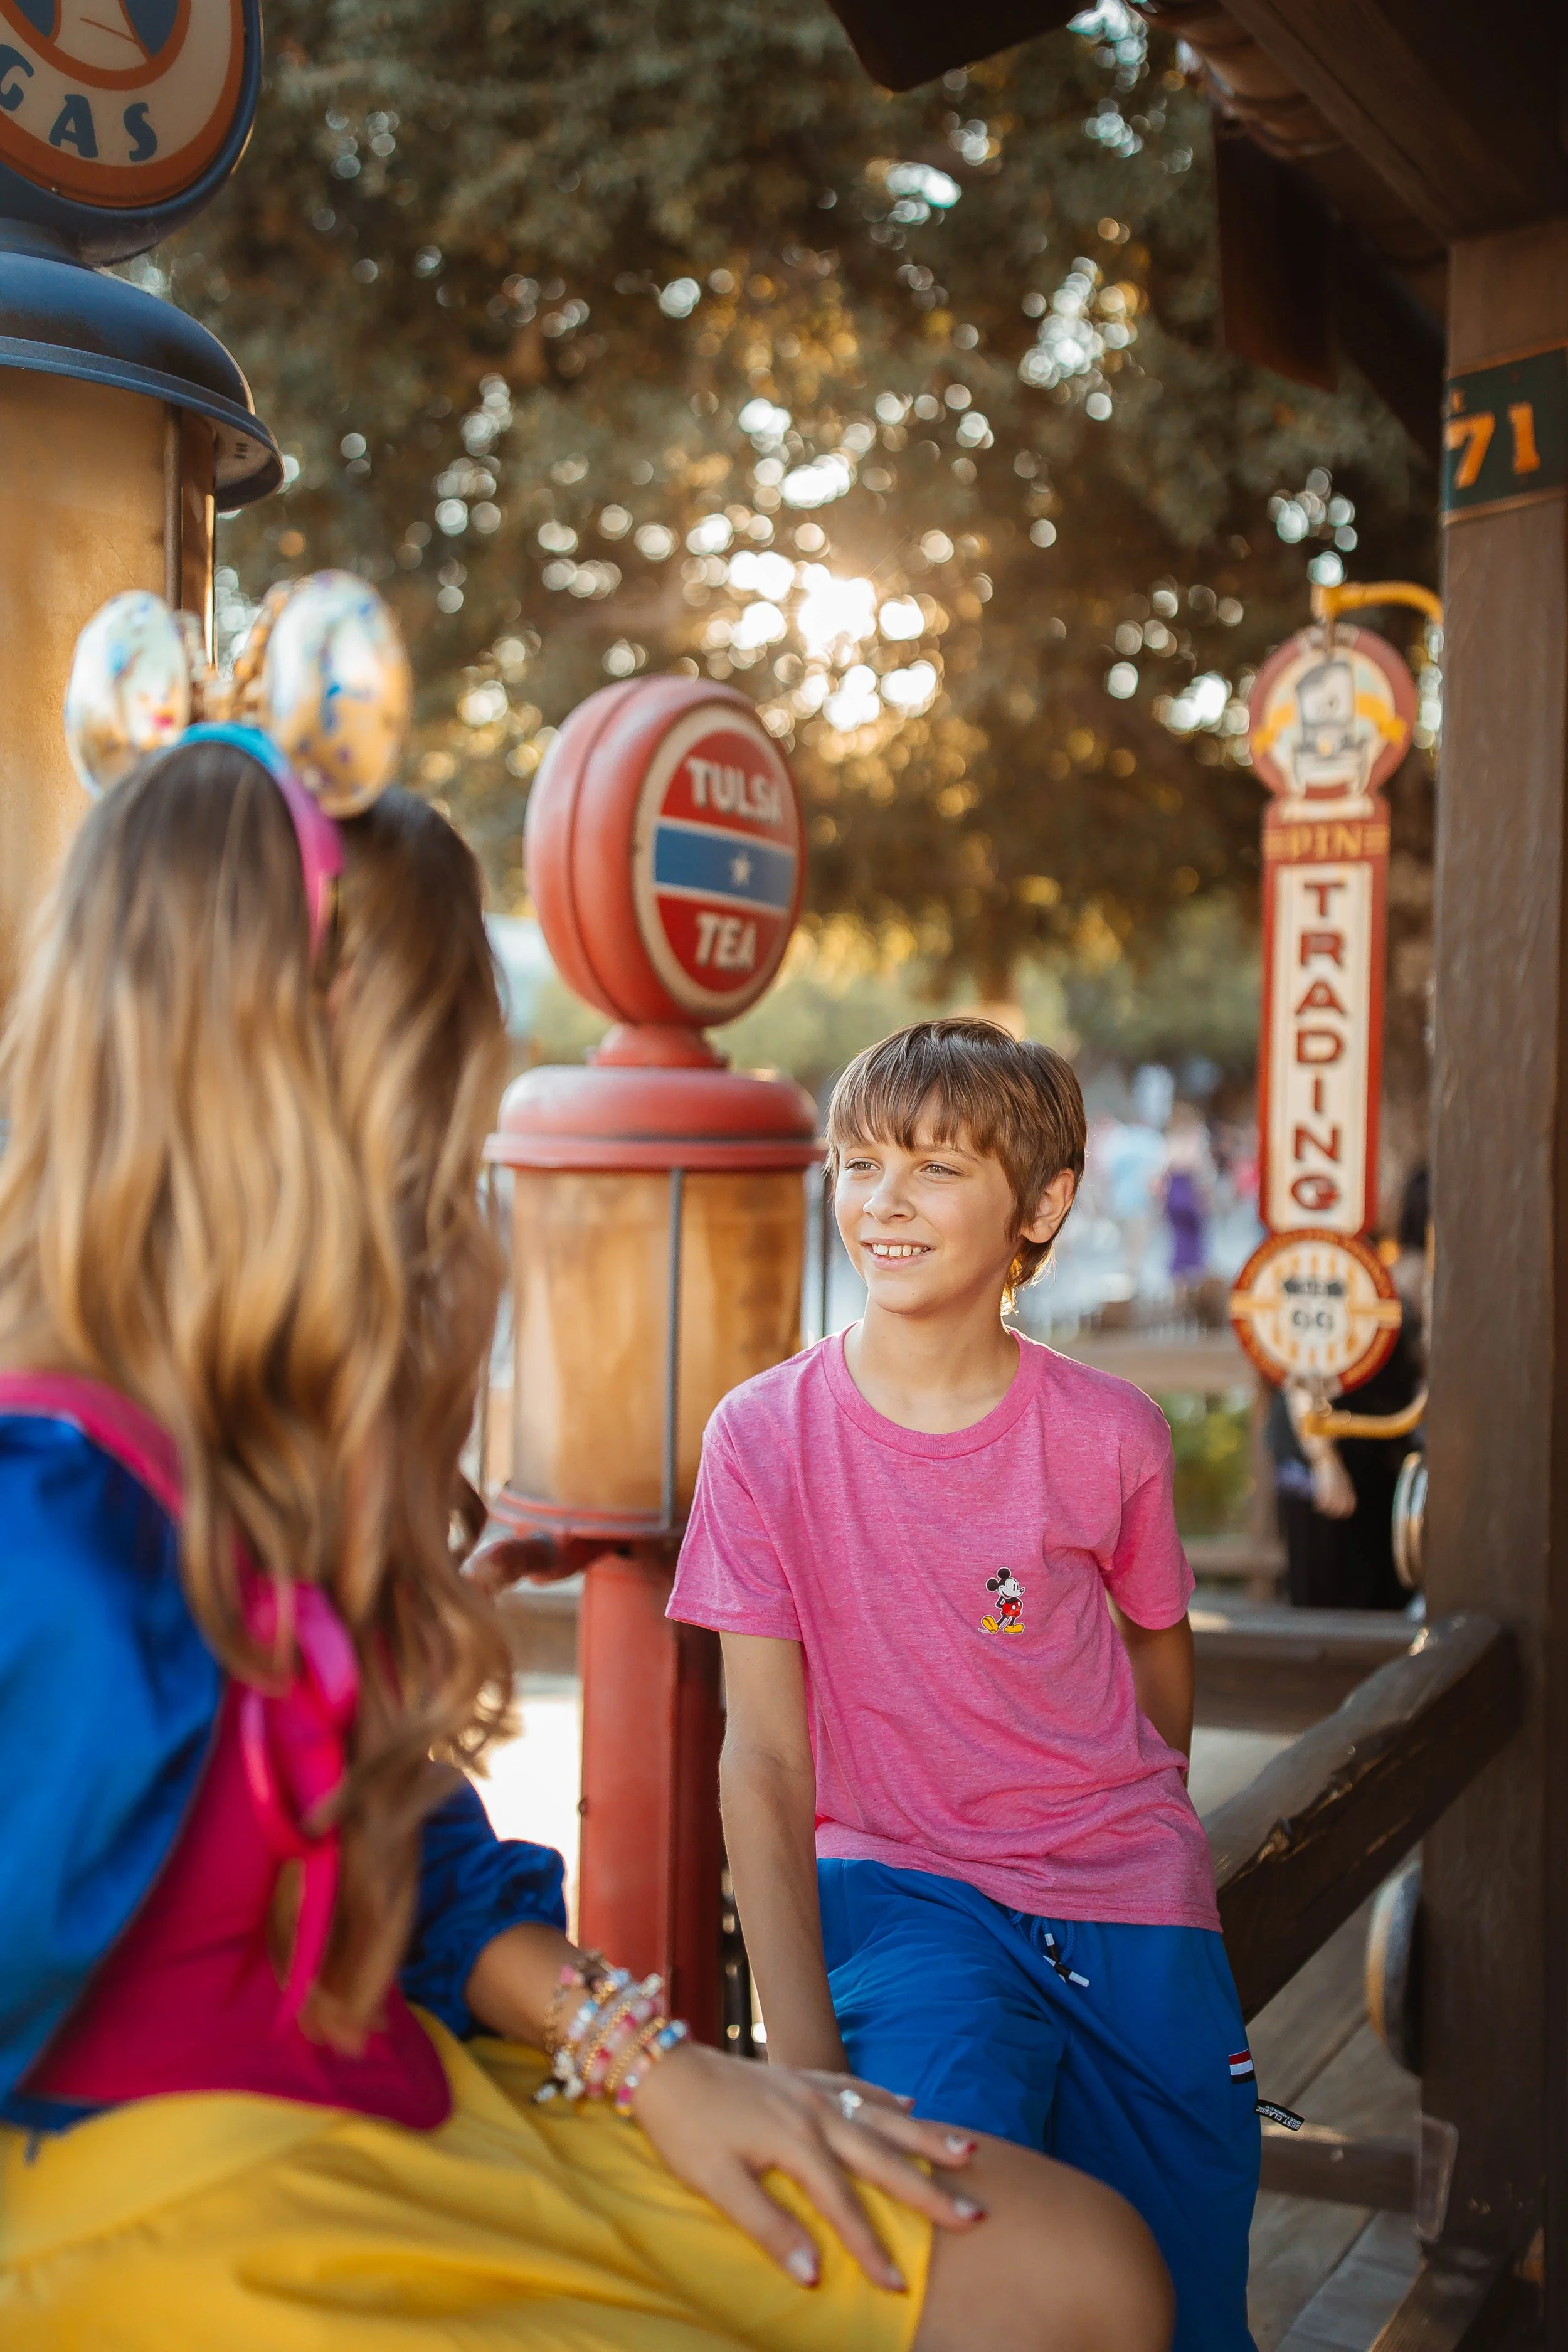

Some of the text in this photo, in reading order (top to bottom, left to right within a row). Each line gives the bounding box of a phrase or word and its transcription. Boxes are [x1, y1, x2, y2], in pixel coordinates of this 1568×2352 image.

[0, 44, 158, 162] GAS
[687, 756, 783, 823] TULSA
[1289, 824, 1363, 861] PIN
[695, 911, 756, 970] TEA
[1291, 882, 1346, 1210] TRADING
[1256, 2106, 1300, 2130] BEST CLASSIC
